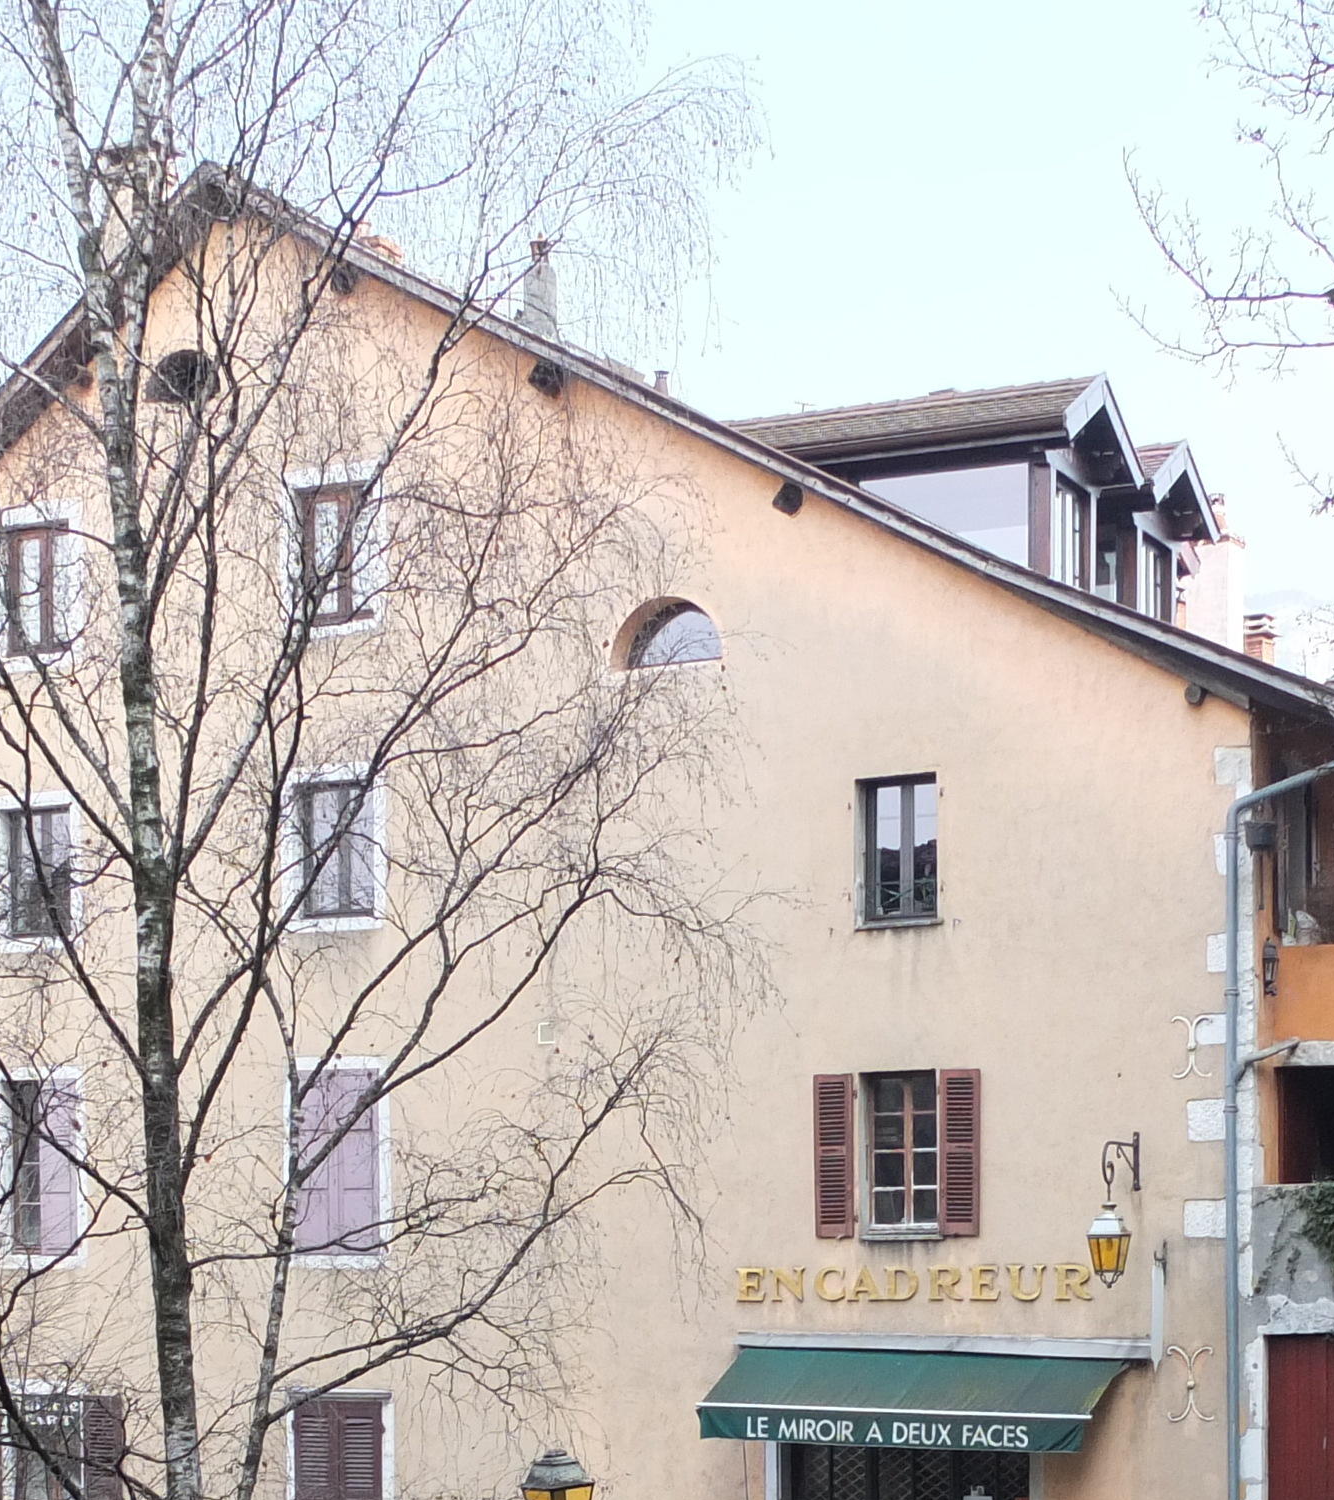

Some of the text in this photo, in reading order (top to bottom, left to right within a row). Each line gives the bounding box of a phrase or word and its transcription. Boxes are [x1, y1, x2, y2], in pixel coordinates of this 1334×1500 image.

[735, 1263, 1093, 1302] ENCADREUR
[746, 1415, 1029, 1449] LE MIROIR A DEUX FACES
